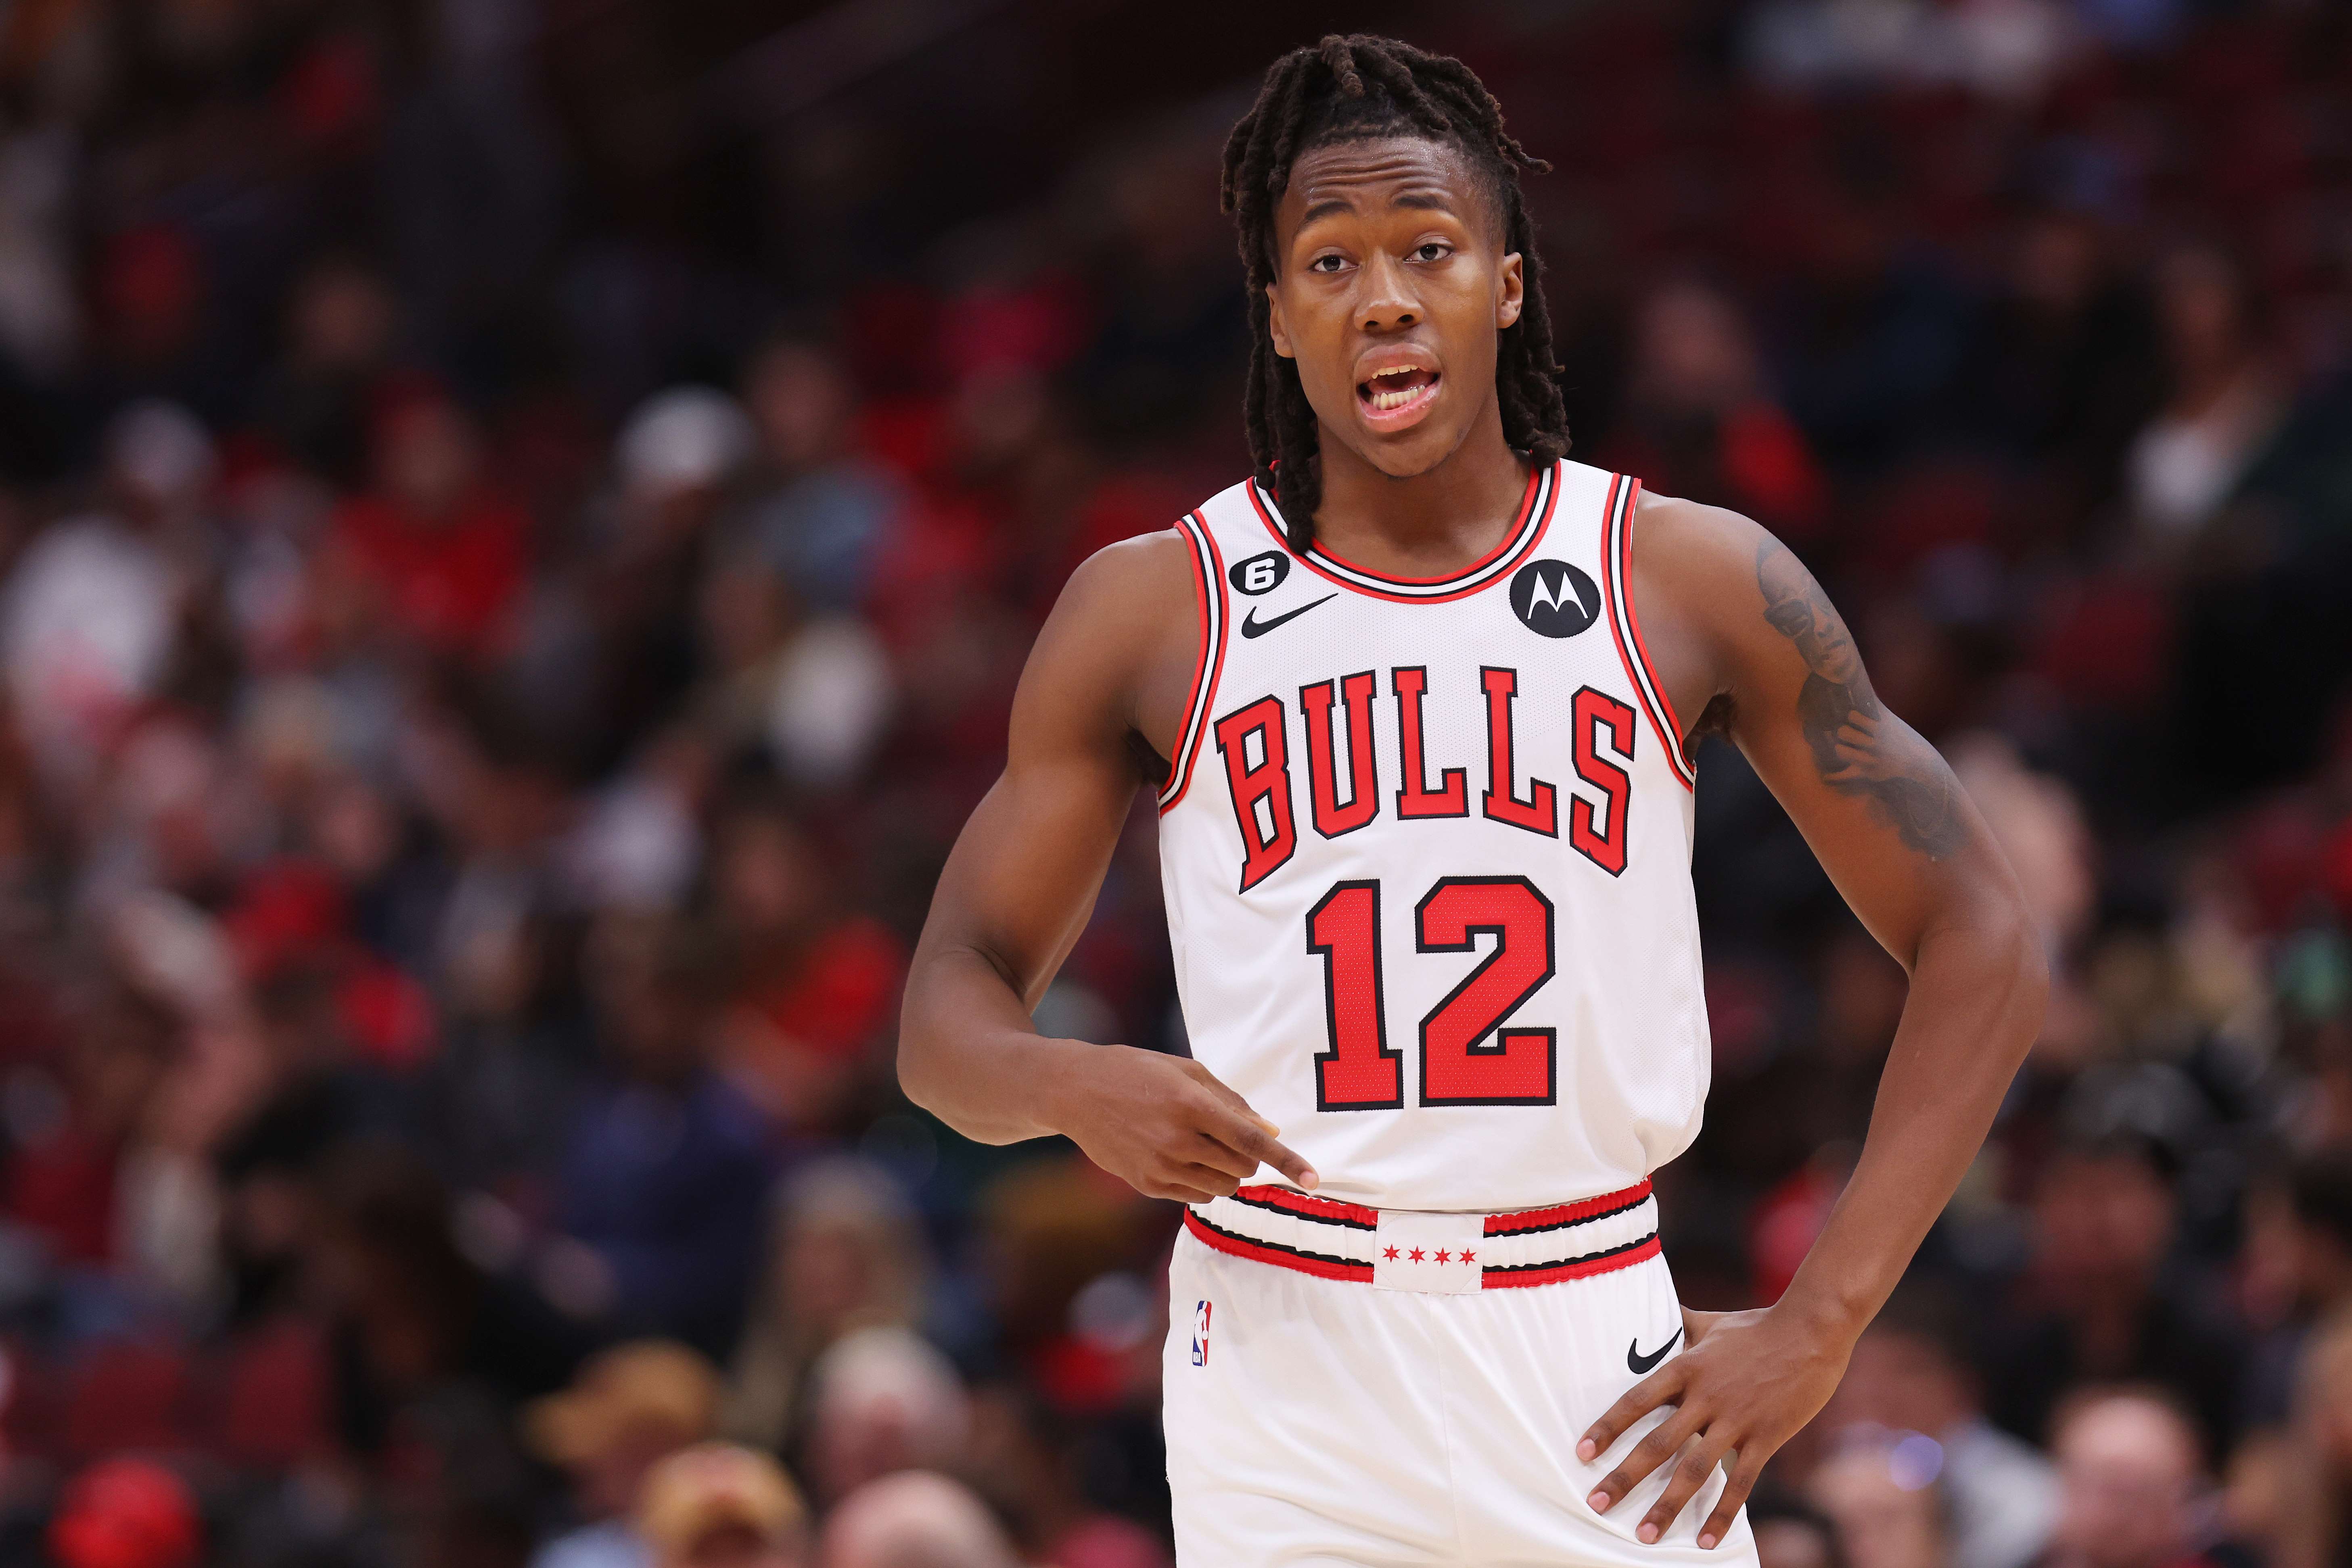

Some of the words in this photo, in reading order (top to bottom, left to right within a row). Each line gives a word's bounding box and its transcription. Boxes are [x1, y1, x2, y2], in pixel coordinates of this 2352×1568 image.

[1245, 558, 1275, 591] 6
[1214, 665, 1636, 895] BULLS
[1306, 875, 1557, 1112] 12
[1193, 1351, 1201, 1363] NBA
